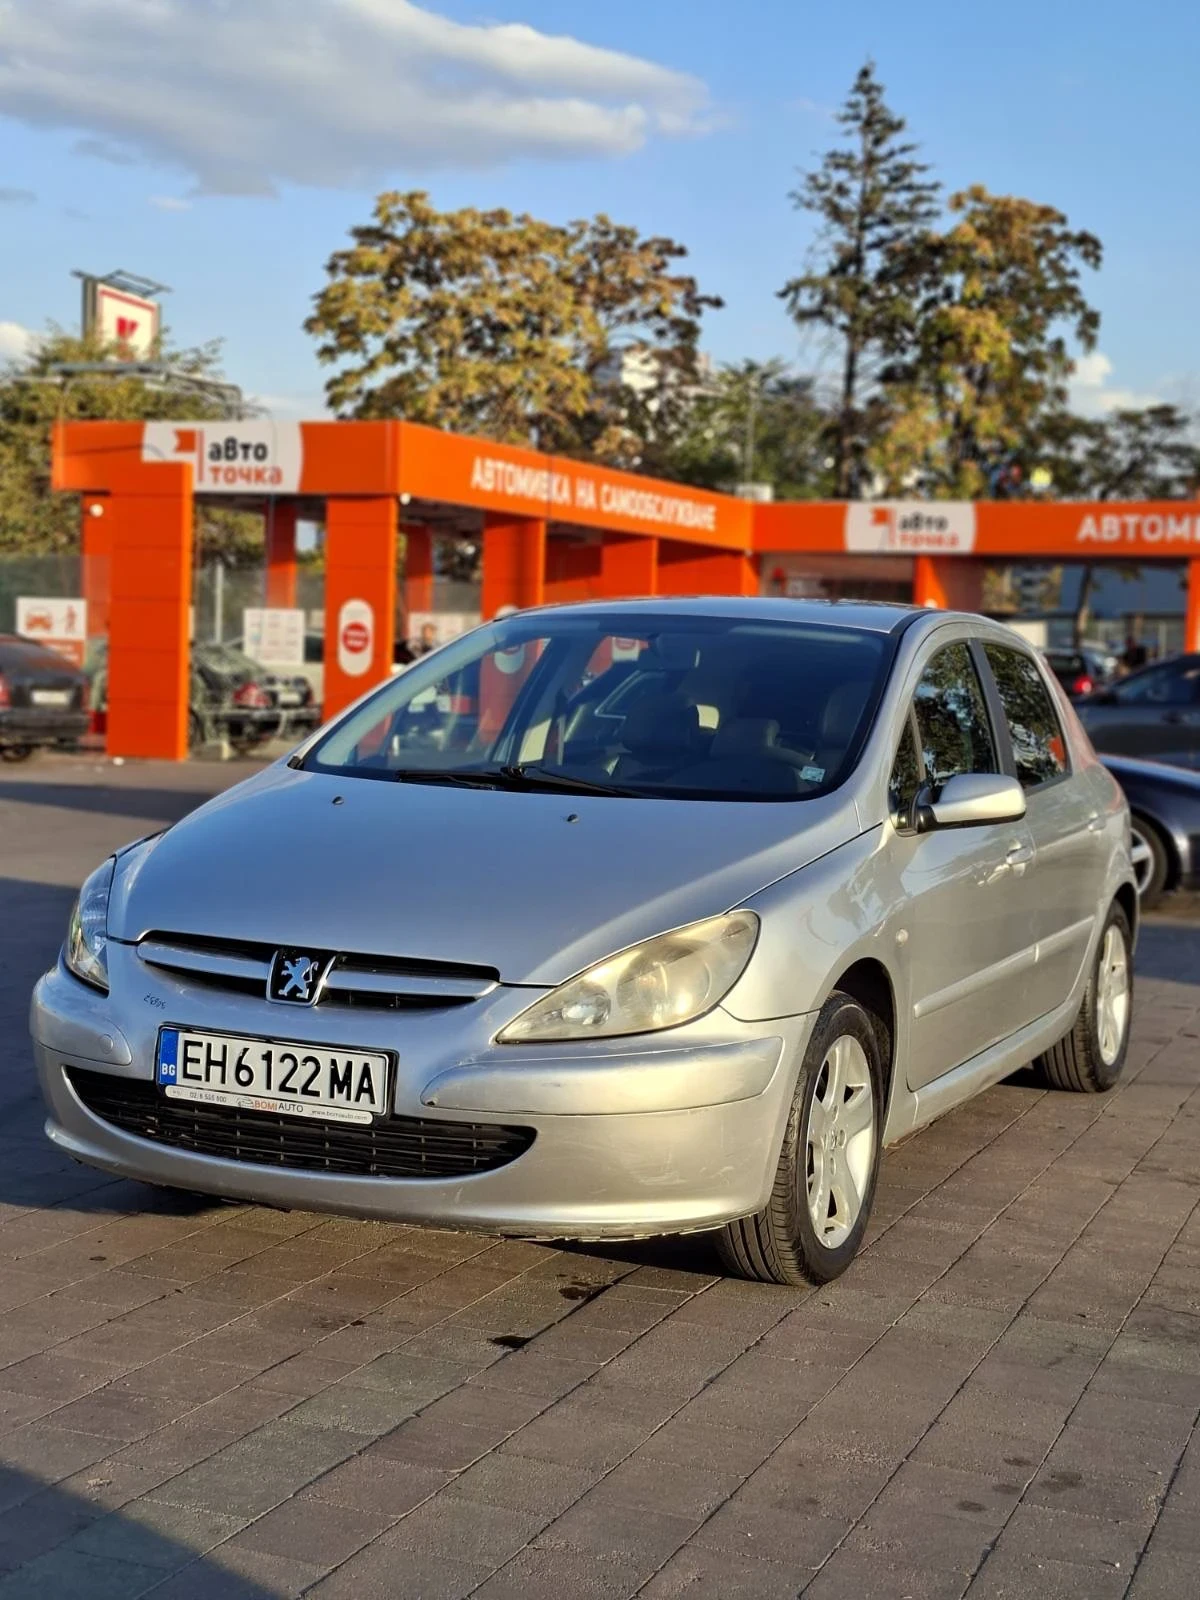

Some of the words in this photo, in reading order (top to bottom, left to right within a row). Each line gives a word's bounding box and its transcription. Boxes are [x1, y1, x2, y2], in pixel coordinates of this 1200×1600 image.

[208, 436, 268, 462] авто
[209, 466, 284, 485] точка
[470, 456, 571, 505] АВТОМИВКА
[575, 476, 596, 511] НА
[161, 1063, 176, 1076] BG
